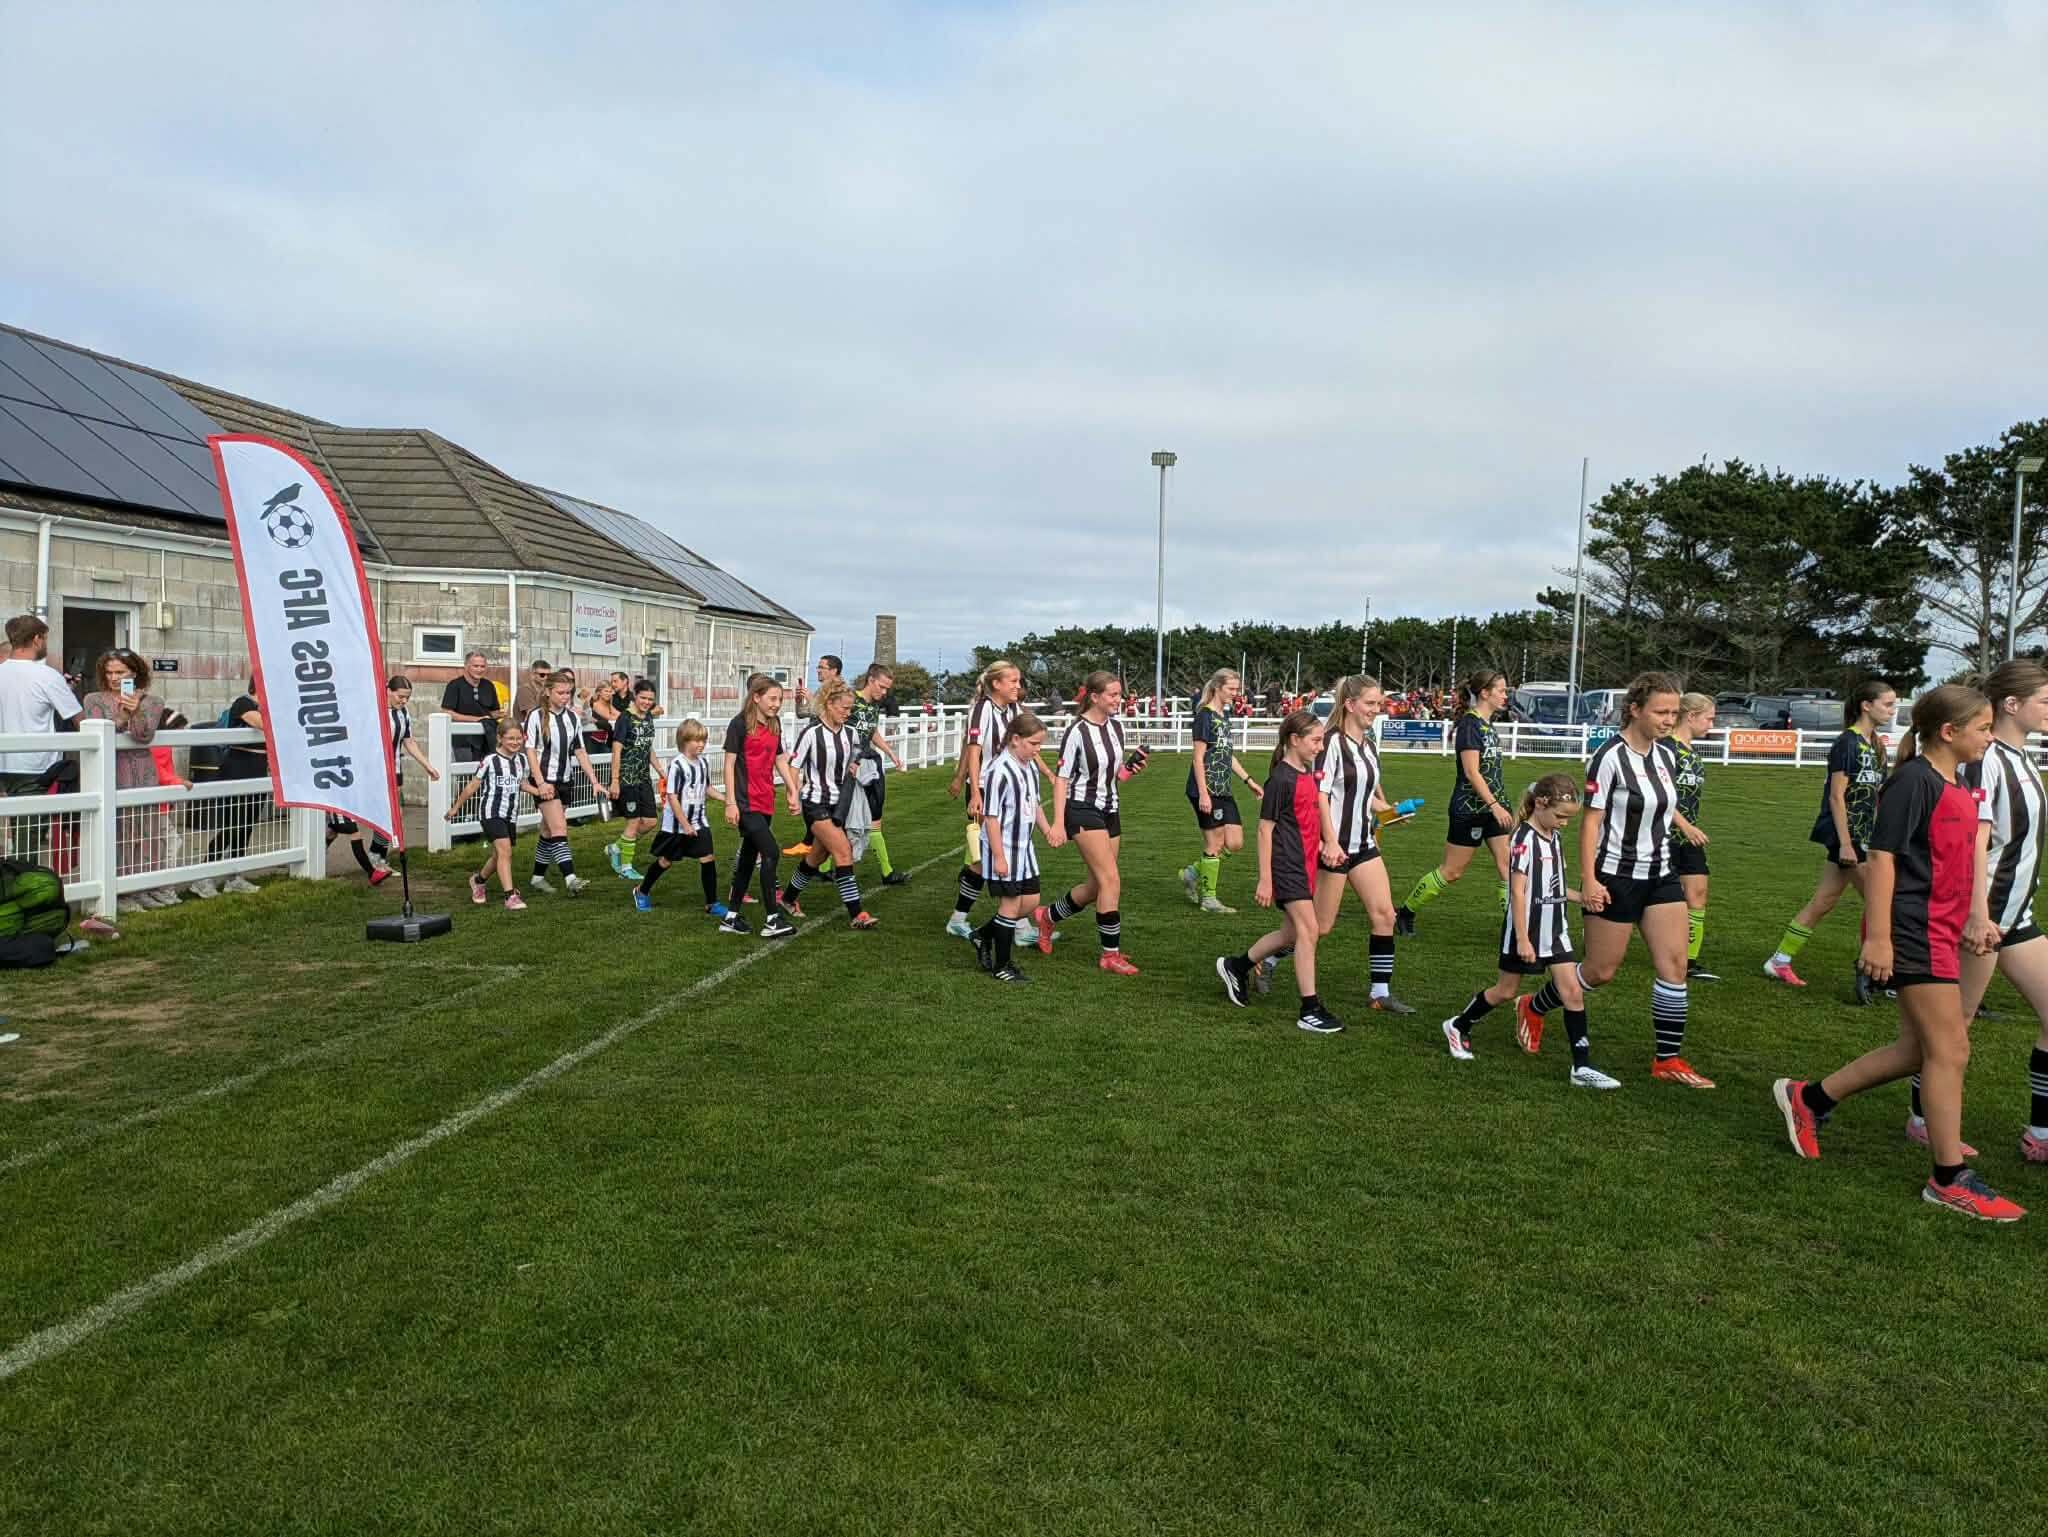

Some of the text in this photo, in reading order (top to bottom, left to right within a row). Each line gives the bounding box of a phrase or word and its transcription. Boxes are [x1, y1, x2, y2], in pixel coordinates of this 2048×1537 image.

[1383, 721, 1407, 729] EDGE
[1589, 727, 1617, 739] Edh
[1734, 733, 1793, 746] goundrys
[498, 776, 521, 786] Edh
